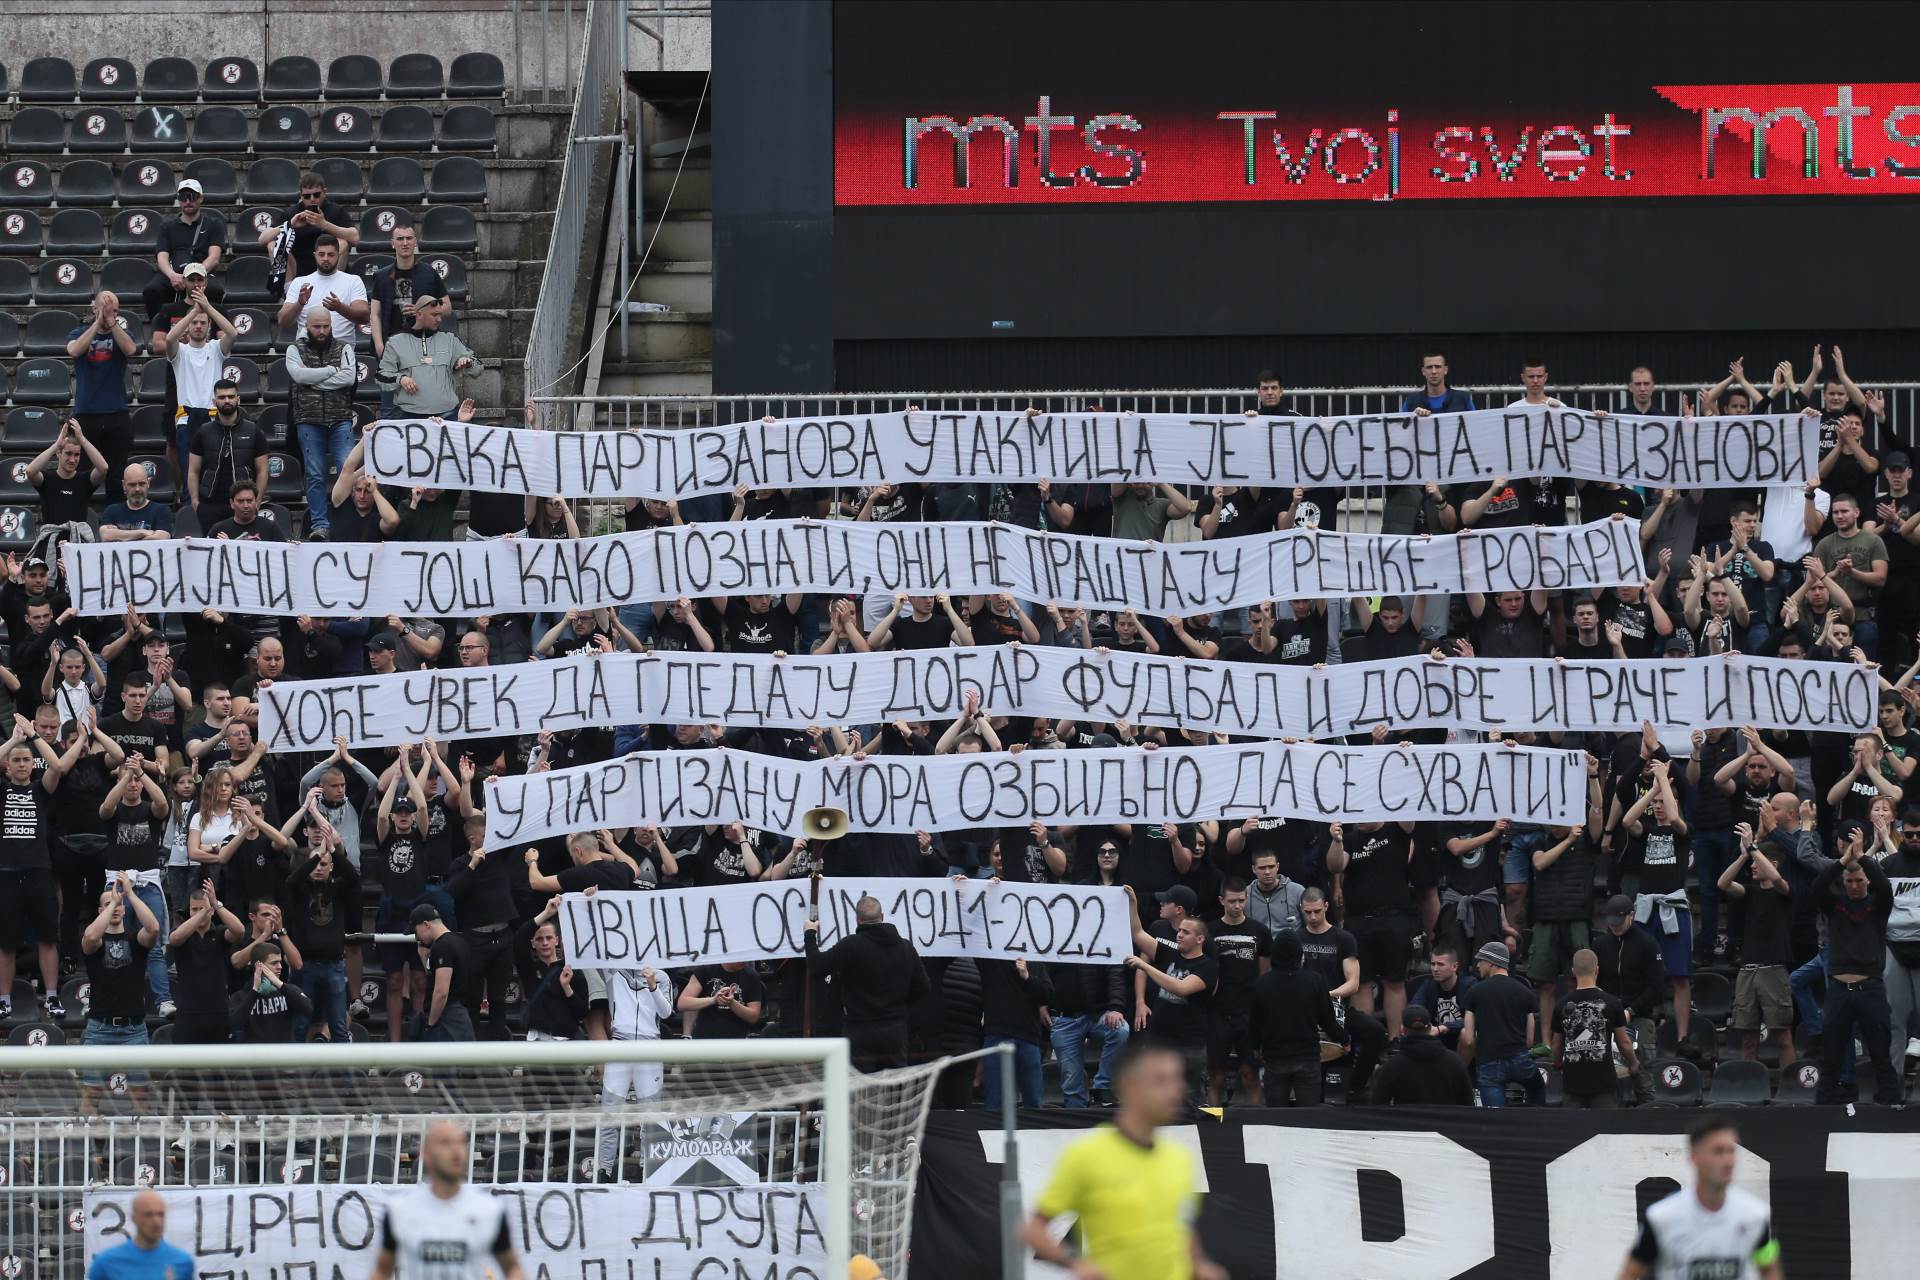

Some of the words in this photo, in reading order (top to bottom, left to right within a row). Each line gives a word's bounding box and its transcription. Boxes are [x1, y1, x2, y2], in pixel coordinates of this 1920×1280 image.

[905, 95, 1146, 190] mts
[1218, 110, 1400, 201] Tvoj
[1432, 113, 1633, 182] svet
[370, 423, 530, 493] СВАКА
[555, 417, 885, 494] ПАРТИЗАНОВА
[904, 414, 1157, 482] УТАКМИЦА
[1188, 420, 1249, 480] ЈЕ
[1268, 414, 1494, 482] ПОСЕБНА.
[1503, 412, 1807, 484] ПАРТИЗАНОВИ
[77, 543, 294, 611] НАВИЈАЧИ
[312, 551, 374, 609] СУ
[401, 548, 495, 614] ЈОШ
[516, 540, 634, 605] КАКО
[653, 523, 872, 595] ПОЗНАТИ,
[876, 525, 952, 591] ОНИ
[968, 527, 1016, 587] НЕ
[1025, 535, 1242, 610] ПРАШТАЈУ
[1268, 534, 1450, 597] ГРЕШКЕ.
[1456, 521, 1642, 592] ГРОБАРИ
[267, 683, 381, 748] ХОЋЕ
[403, 674, 521, 734] УВЕК
[539, 659, 612, 726] ДА
[636, 657, 857, 726] ГЛЕДАЈУ
[880, 649, 1041, 719] ДОБАР
[1062, 656, 1284, 730] ФУДБАЛ
[1305, 675, 1333, 733] И
[1349, 661, 1506, 730] ДОБРЕ
[1530, 665, 1690, 728] ИГРАЧЕ
[1703, 664, 1734, 721] И
[1747, 667, 1873, 729] ПОСАО
[4, 809, 37, 818] adidas
[4, 825, 36, 835] adidas
[493, 782, 527, 840] У
[546, 755, 801, 831] ПАРТИЗАНУ
[815, 763, 937, 827] МОРА
[958, 754, 1202, 822] ОЗБИЉНО
[1220, 750, 1298, 817] ДА
[1313, 750, 1364, 815] СЕ
[1378, 750, 1579, 820] СХВАТИ!"
[566, 898, 730, 962] ИВИЦА
[890, 888, 1112, 958] 1941-2022
[1894, 881, 1920, 897] NIK
[649, 1138, 754, 1159] КУМОДРАЖ
[631, 1188, 828, 1255] ДРУГА
